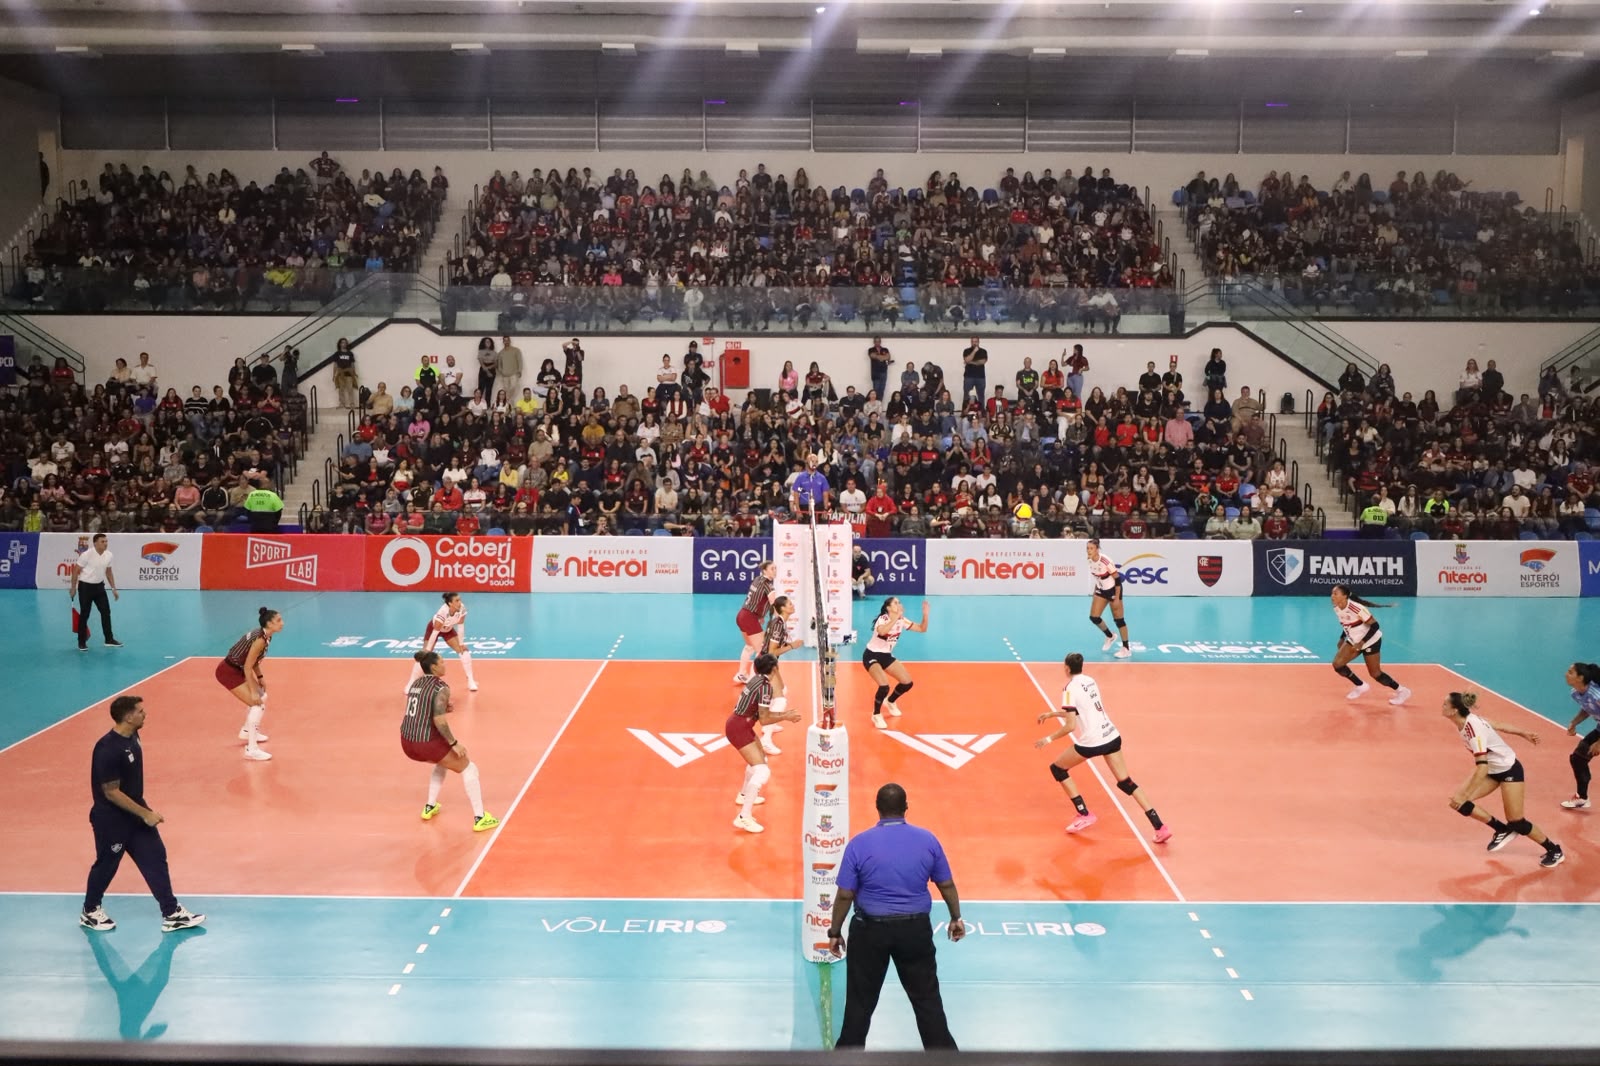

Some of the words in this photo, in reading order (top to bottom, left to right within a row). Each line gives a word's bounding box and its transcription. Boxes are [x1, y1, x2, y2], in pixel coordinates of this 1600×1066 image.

[252, 543, 286, 562] SPORT
[435, 537, 512, 563] Caberj
[139, 565, 180, 575] NITERÓI
[291, 562, 313, 579] LAB
[434, 559, 516, 584] Integral
[1309, 556, 1404, 576] FAMATH
[702, 571, 762, 581] BRASI
[876, 572, 916, 582] ASIL
[1310, 577, 1350, 585] FACULDADE
[1520, 573, 1560, 582] NITERÓI
